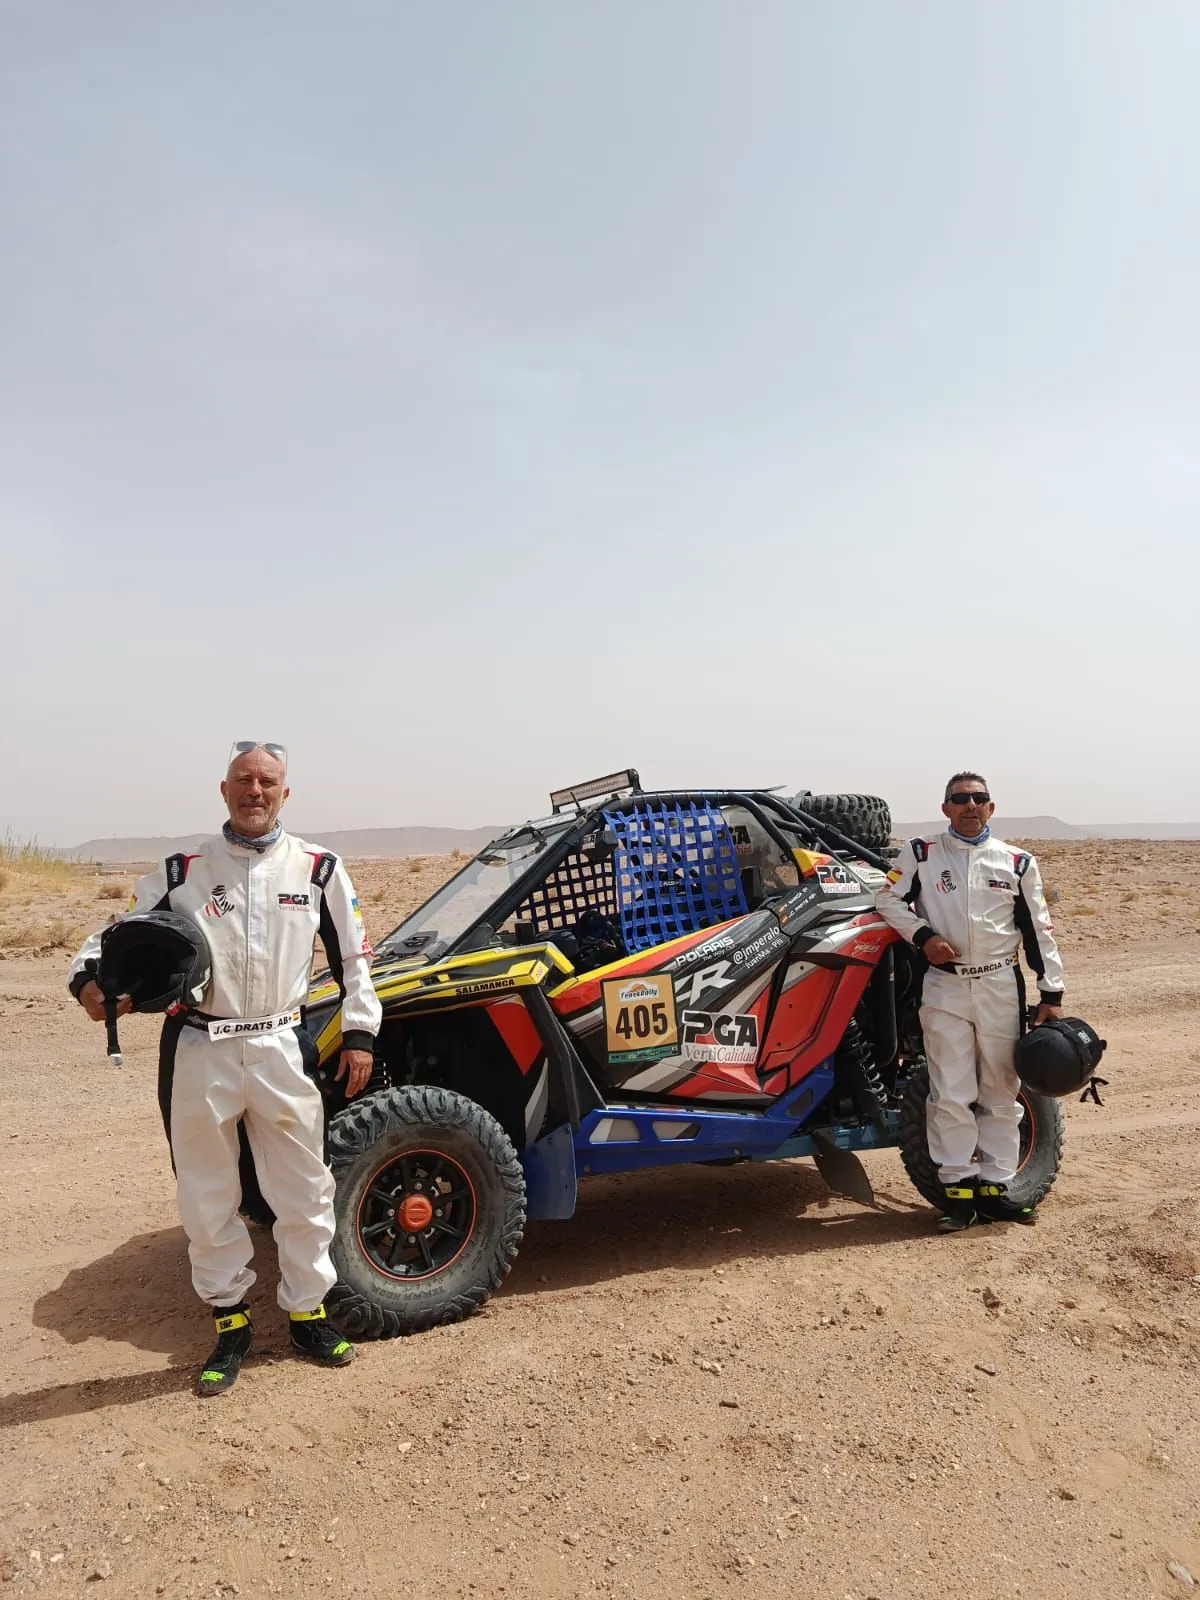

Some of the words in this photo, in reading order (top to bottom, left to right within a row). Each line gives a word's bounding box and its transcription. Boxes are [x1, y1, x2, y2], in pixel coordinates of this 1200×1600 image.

[817, 865, 859, 884] PGA
[675, 936, 734, 967] POLARIS
[733, 926, 780, 965] @jmperalo
[961, 962, 1002, 976] P.GARCIA
[455, 979, 516, 996] SALAMANCA
[615, 1002, 668, 1040] 405
[683, 1012, 758, 1047] PGA
[684, 1044, 758, 1063] VertiCalidad
